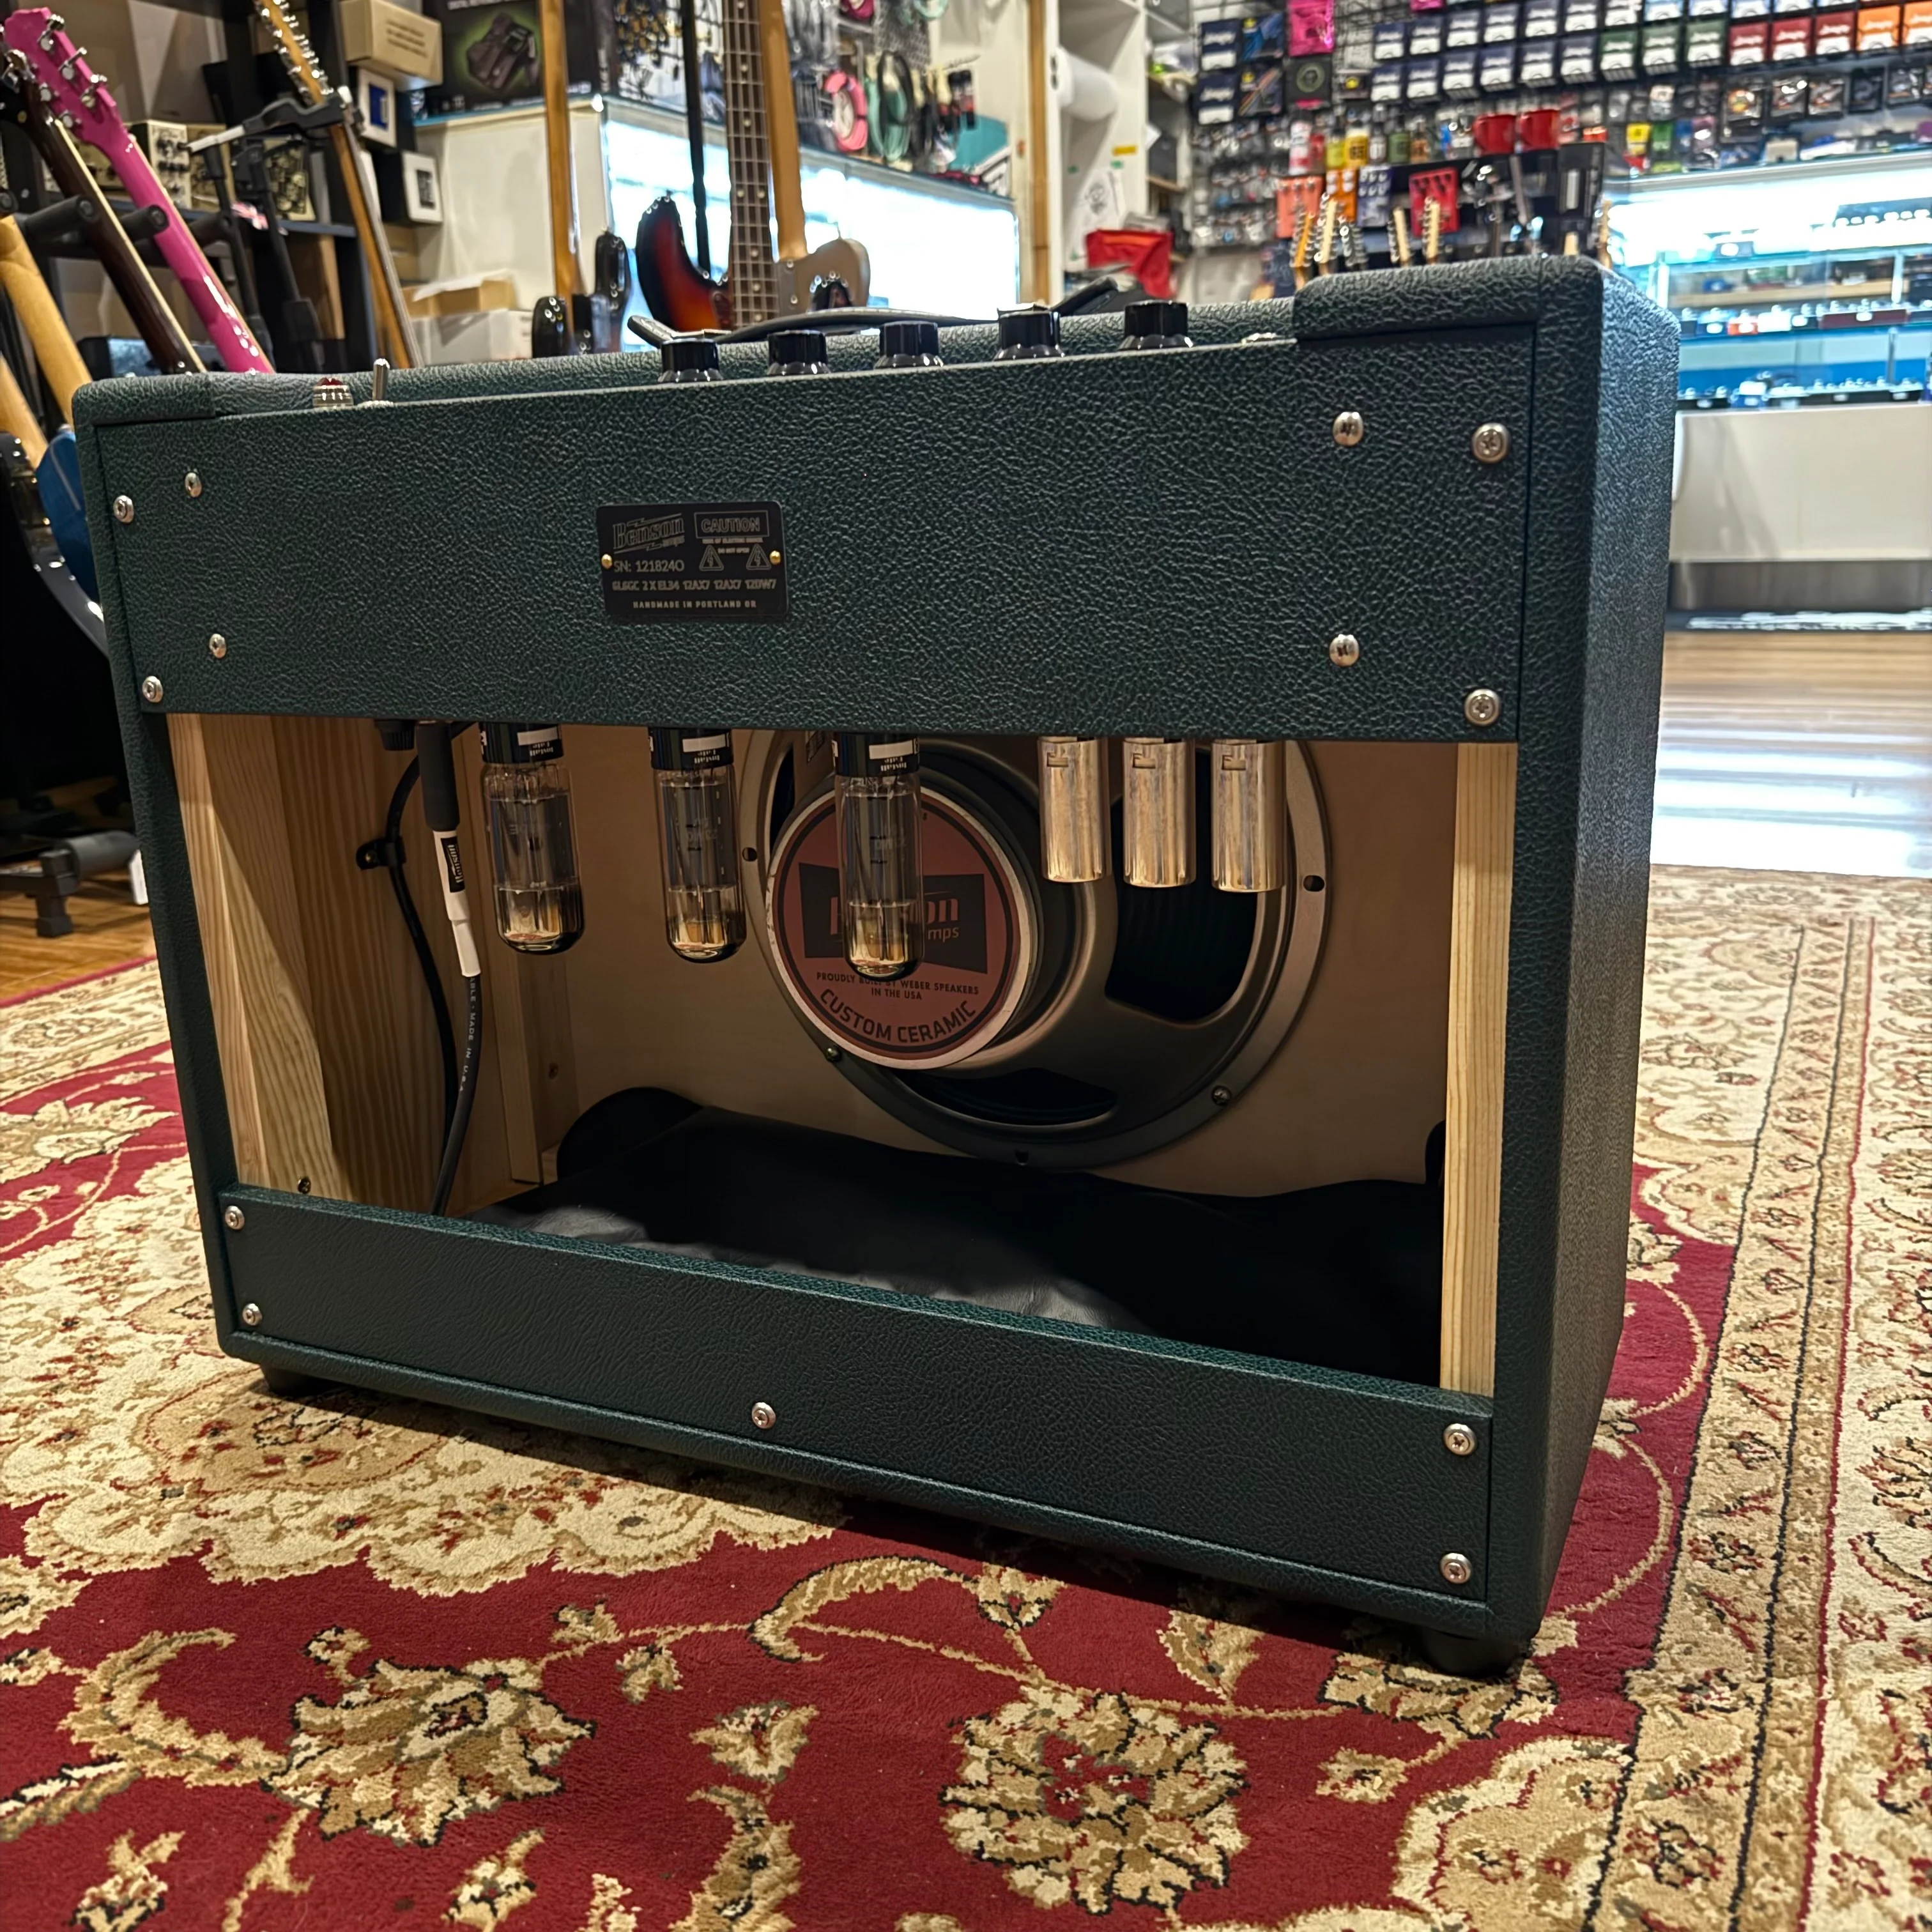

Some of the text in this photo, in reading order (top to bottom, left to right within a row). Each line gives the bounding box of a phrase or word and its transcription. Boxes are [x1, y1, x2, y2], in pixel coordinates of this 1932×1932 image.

[701, 517, 760, 533] CAUTION
[613, 517, 685, 550] Benson
[613, 560, 631, 572] SN:
[642, 581, 648, 590] 2
[658, 580, 680, 590] EL34
[682, 579, 710, 590] 12AX7
[714, 579, 742, 590] 12AX7
[632, 601, 680, 609] HANDMADE
[744, 600, 756, 608] OR
[927, 926, 960, 943] mps
[816, 972, 855, 984] PROUDLY
[900, 980, 930, 990] WEBER
[934, 983, 979, 995] SPEAKERS
[871, 988, 923, 1000] IN THE USA
[820, 988, 977, 1043] CUSTOM CERAMIC
[465, 1048, 471, 1059] IN
